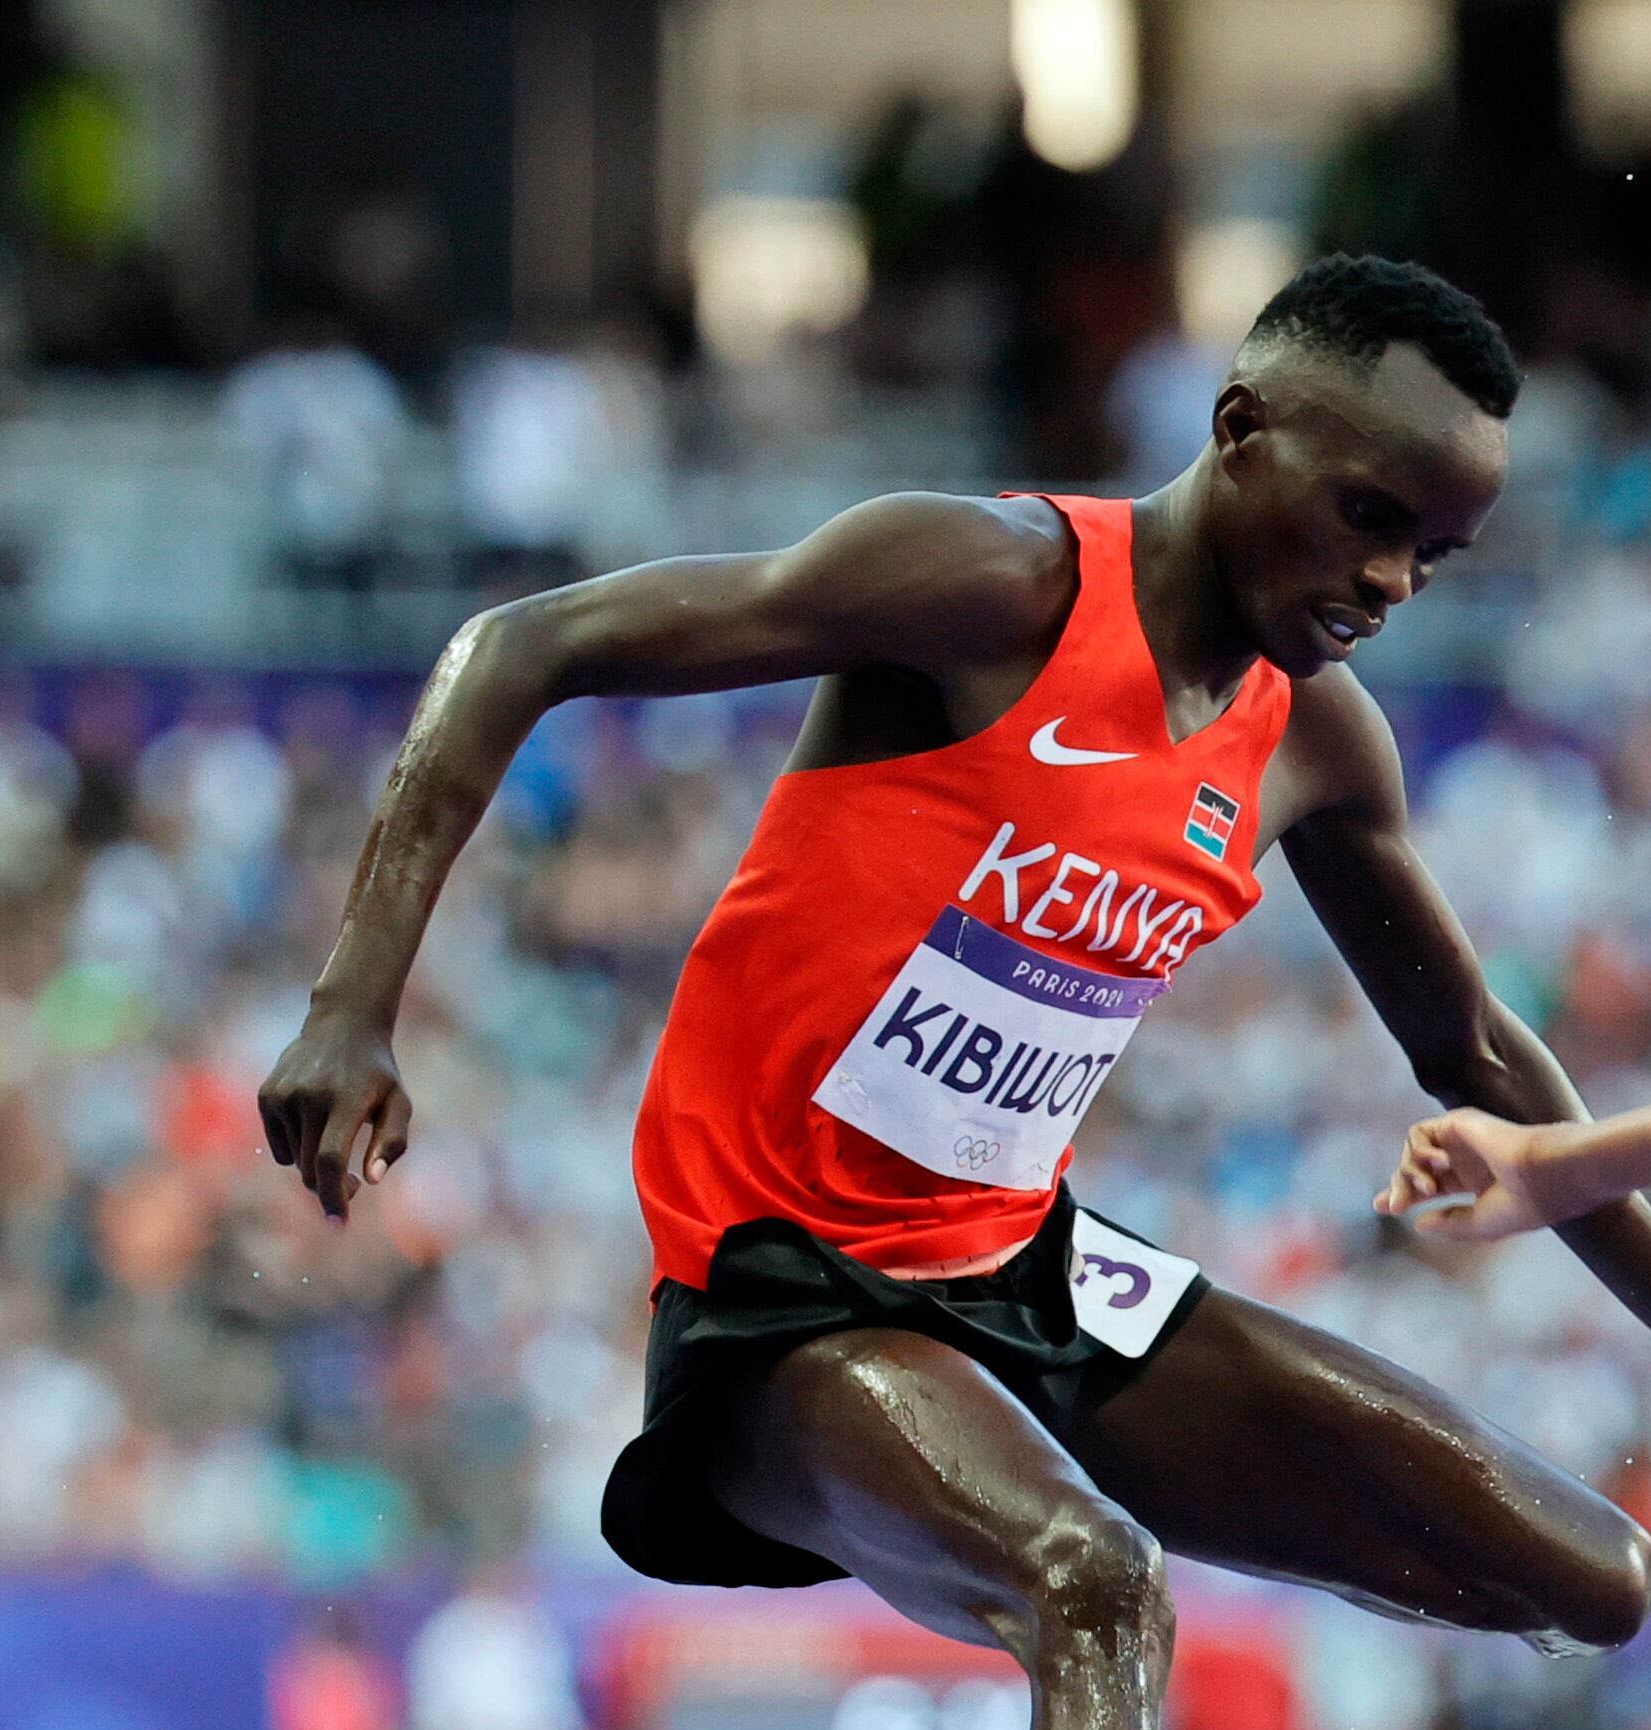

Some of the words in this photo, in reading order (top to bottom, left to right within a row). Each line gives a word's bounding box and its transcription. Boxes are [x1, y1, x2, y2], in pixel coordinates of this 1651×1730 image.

[958, 822, 1203, 980] KENYA
[1012, 960, 1080, 998] PARIS
[872, 986, 1114, 1117] KIBIWOT
[1074, 1254, 1151, 1309] 3
